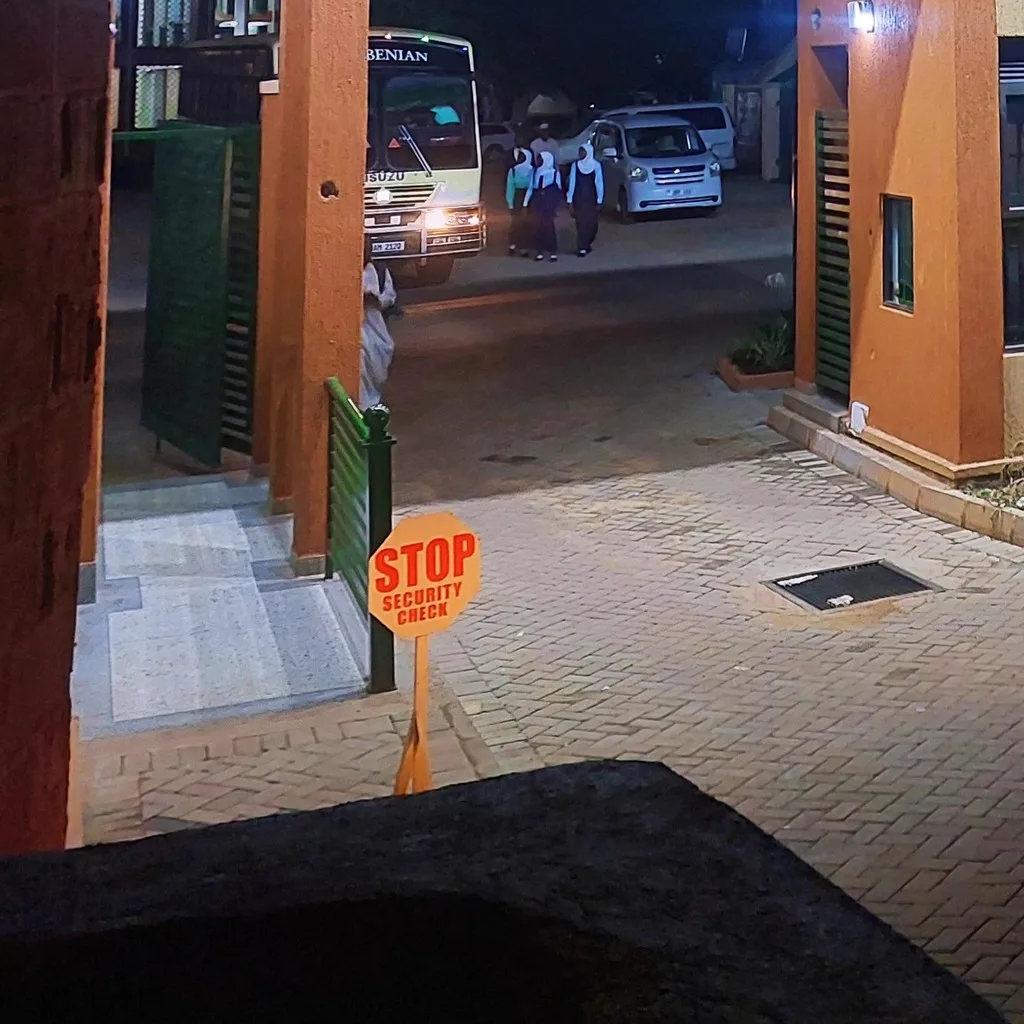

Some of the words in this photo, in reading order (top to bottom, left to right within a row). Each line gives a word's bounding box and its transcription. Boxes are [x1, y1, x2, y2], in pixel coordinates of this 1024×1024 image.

[367, 48, 428, 62] BENIAN
[375, 533, 475, 593] STOP
[382, 581, 462, 612] SECURITY
[397, 602, 448, 626] CHECK
